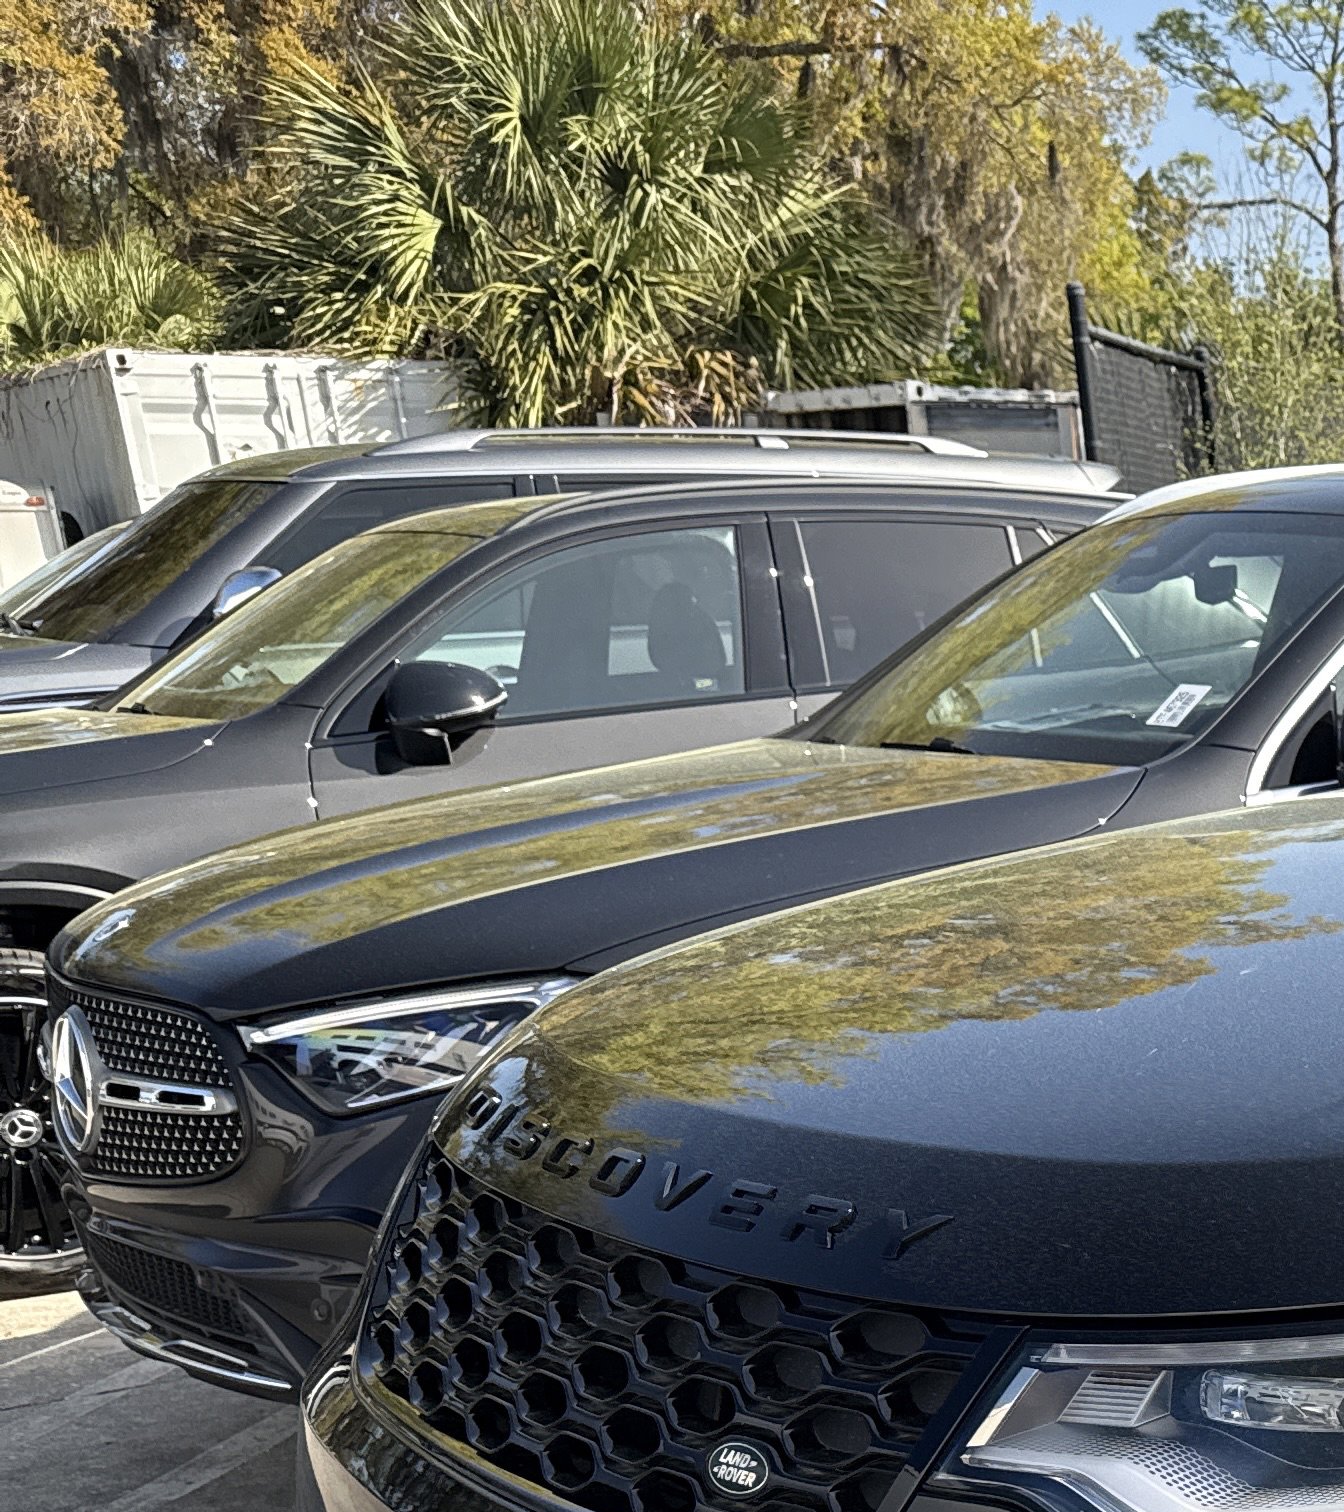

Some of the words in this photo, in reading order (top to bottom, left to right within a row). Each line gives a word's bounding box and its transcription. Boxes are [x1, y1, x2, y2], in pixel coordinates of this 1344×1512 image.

[464, 1088, 956, 1261] DISCOVERY
[718, 1447, 752, 1468] LAND
[716, 1465, 757, 1488] ROVER
